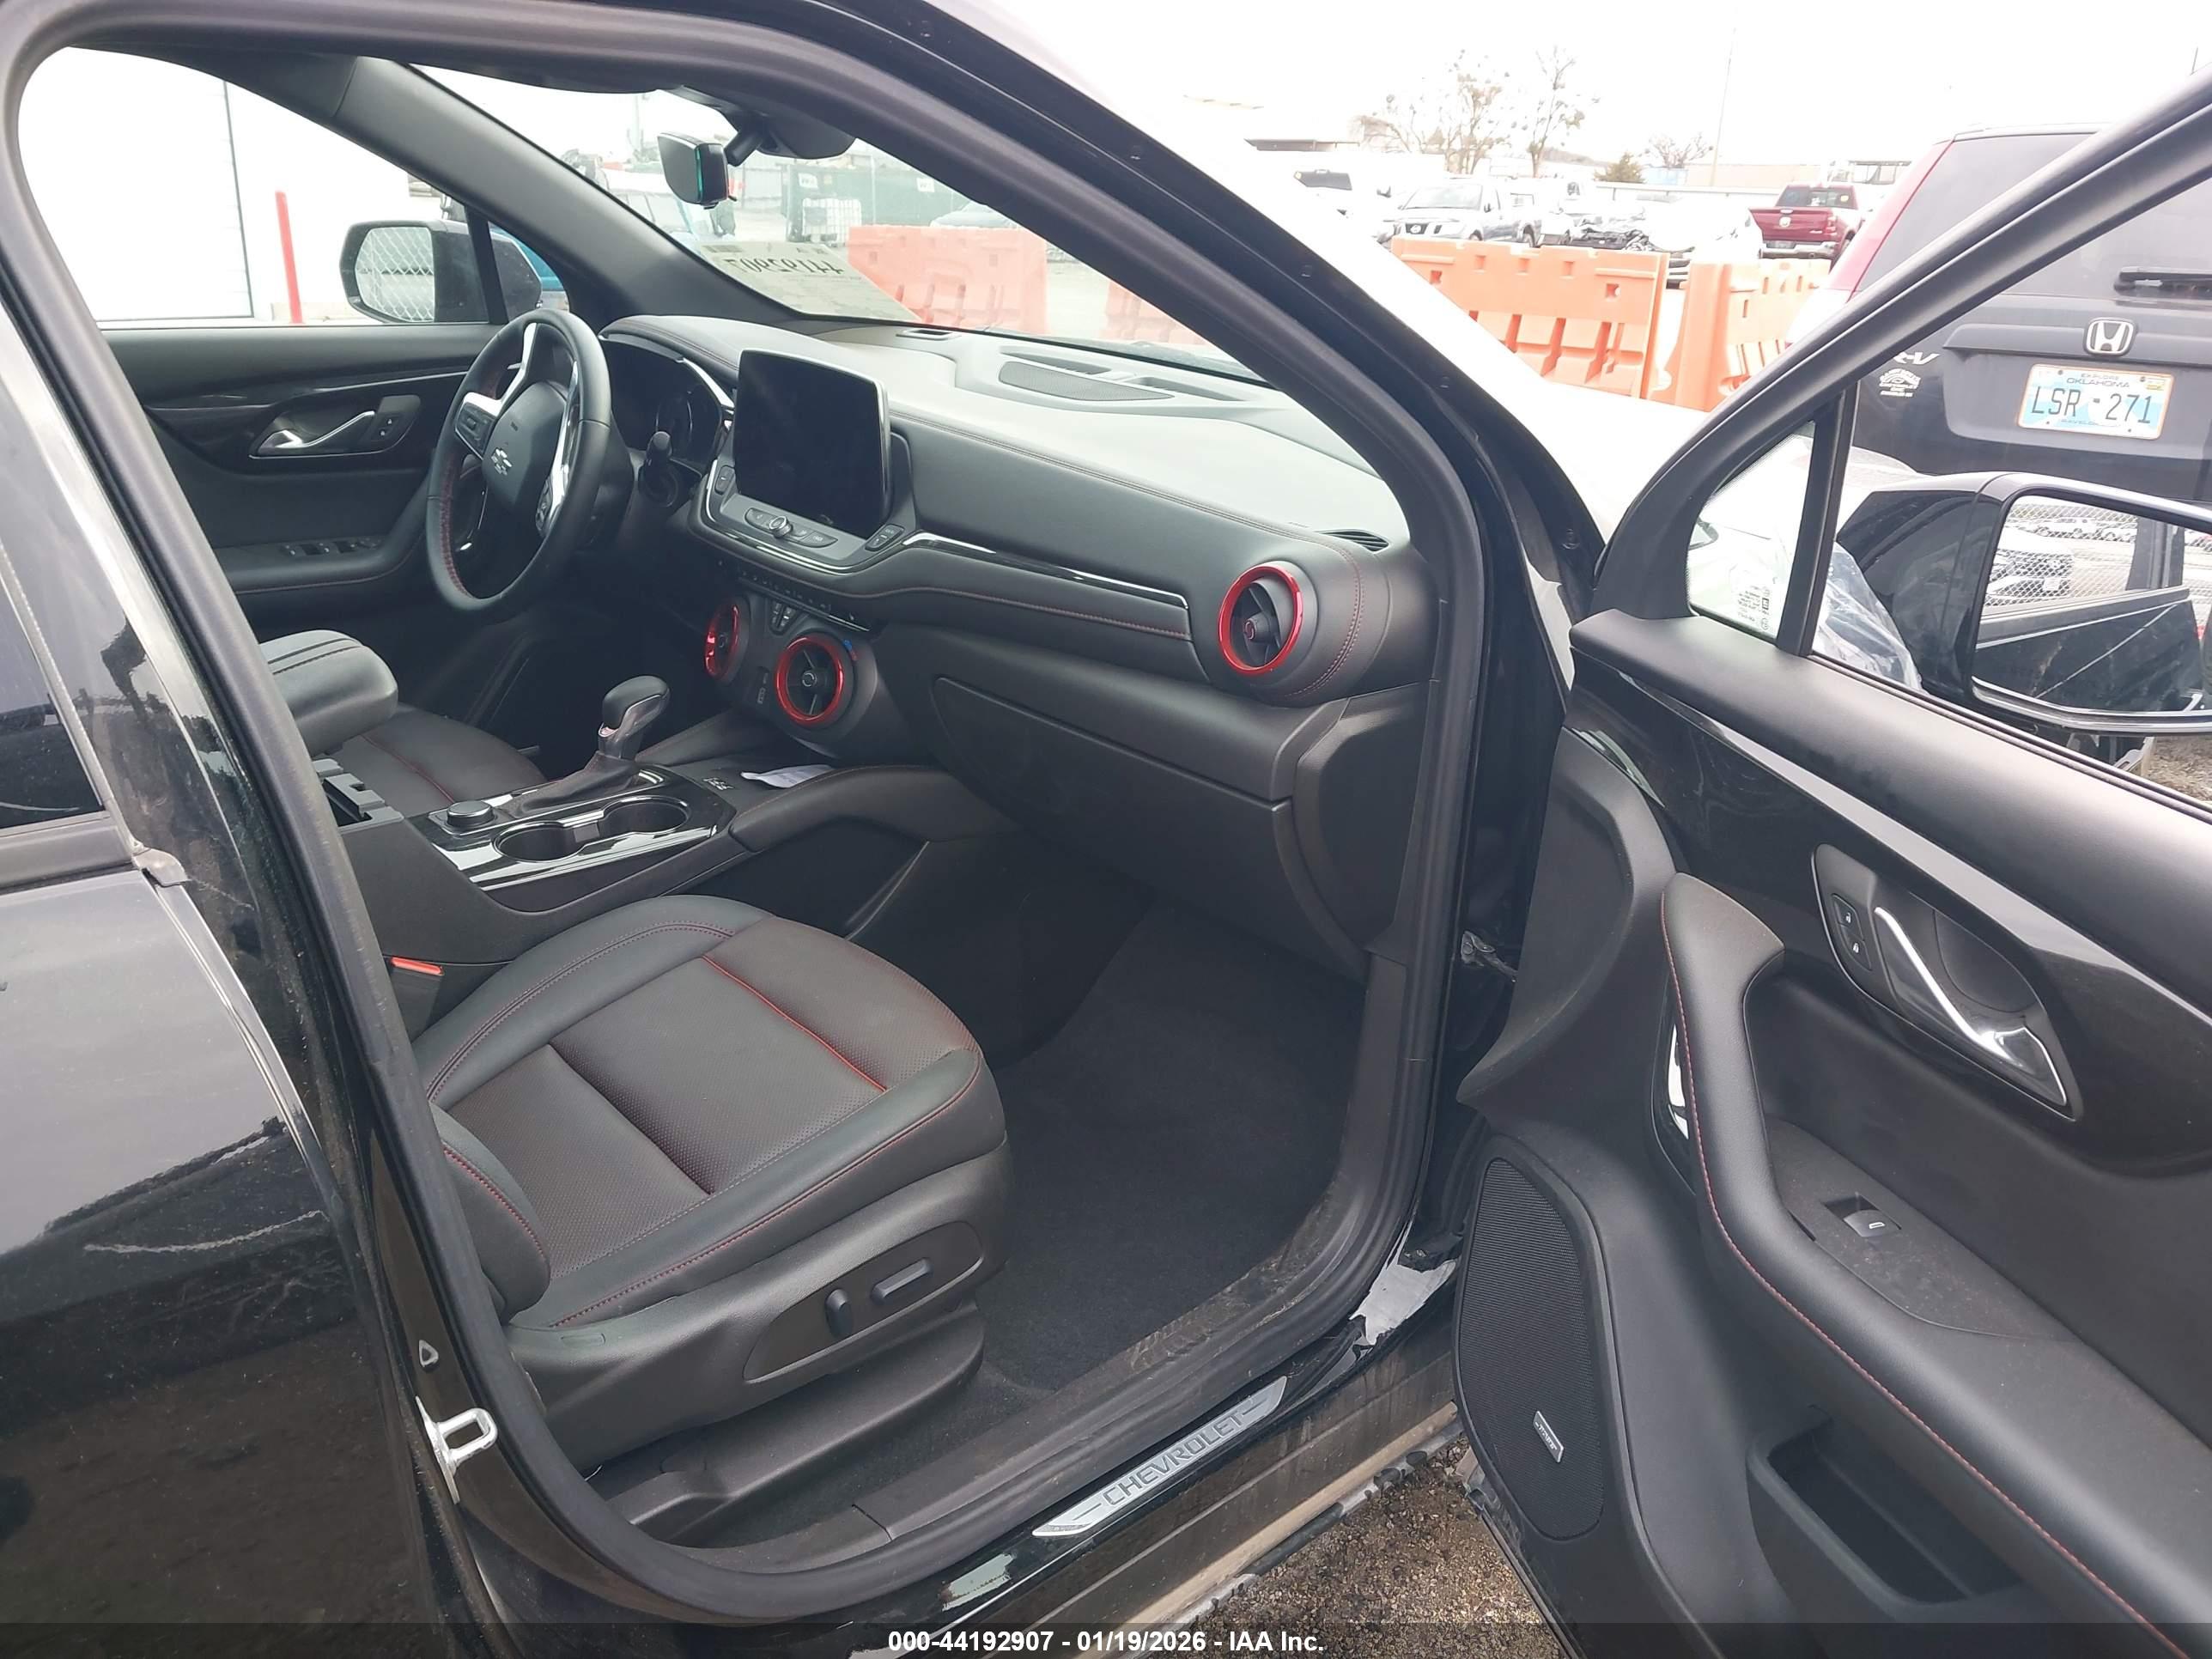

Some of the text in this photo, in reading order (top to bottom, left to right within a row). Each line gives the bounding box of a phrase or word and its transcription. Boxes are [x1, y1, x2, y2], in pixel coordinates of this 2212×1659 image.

[2066, 377, 2130, 388] OKLAHOMA
[2031, 386, 2153, 424] LSR 271
[1103, 1410, 1244, 1506] CHEVROLET
